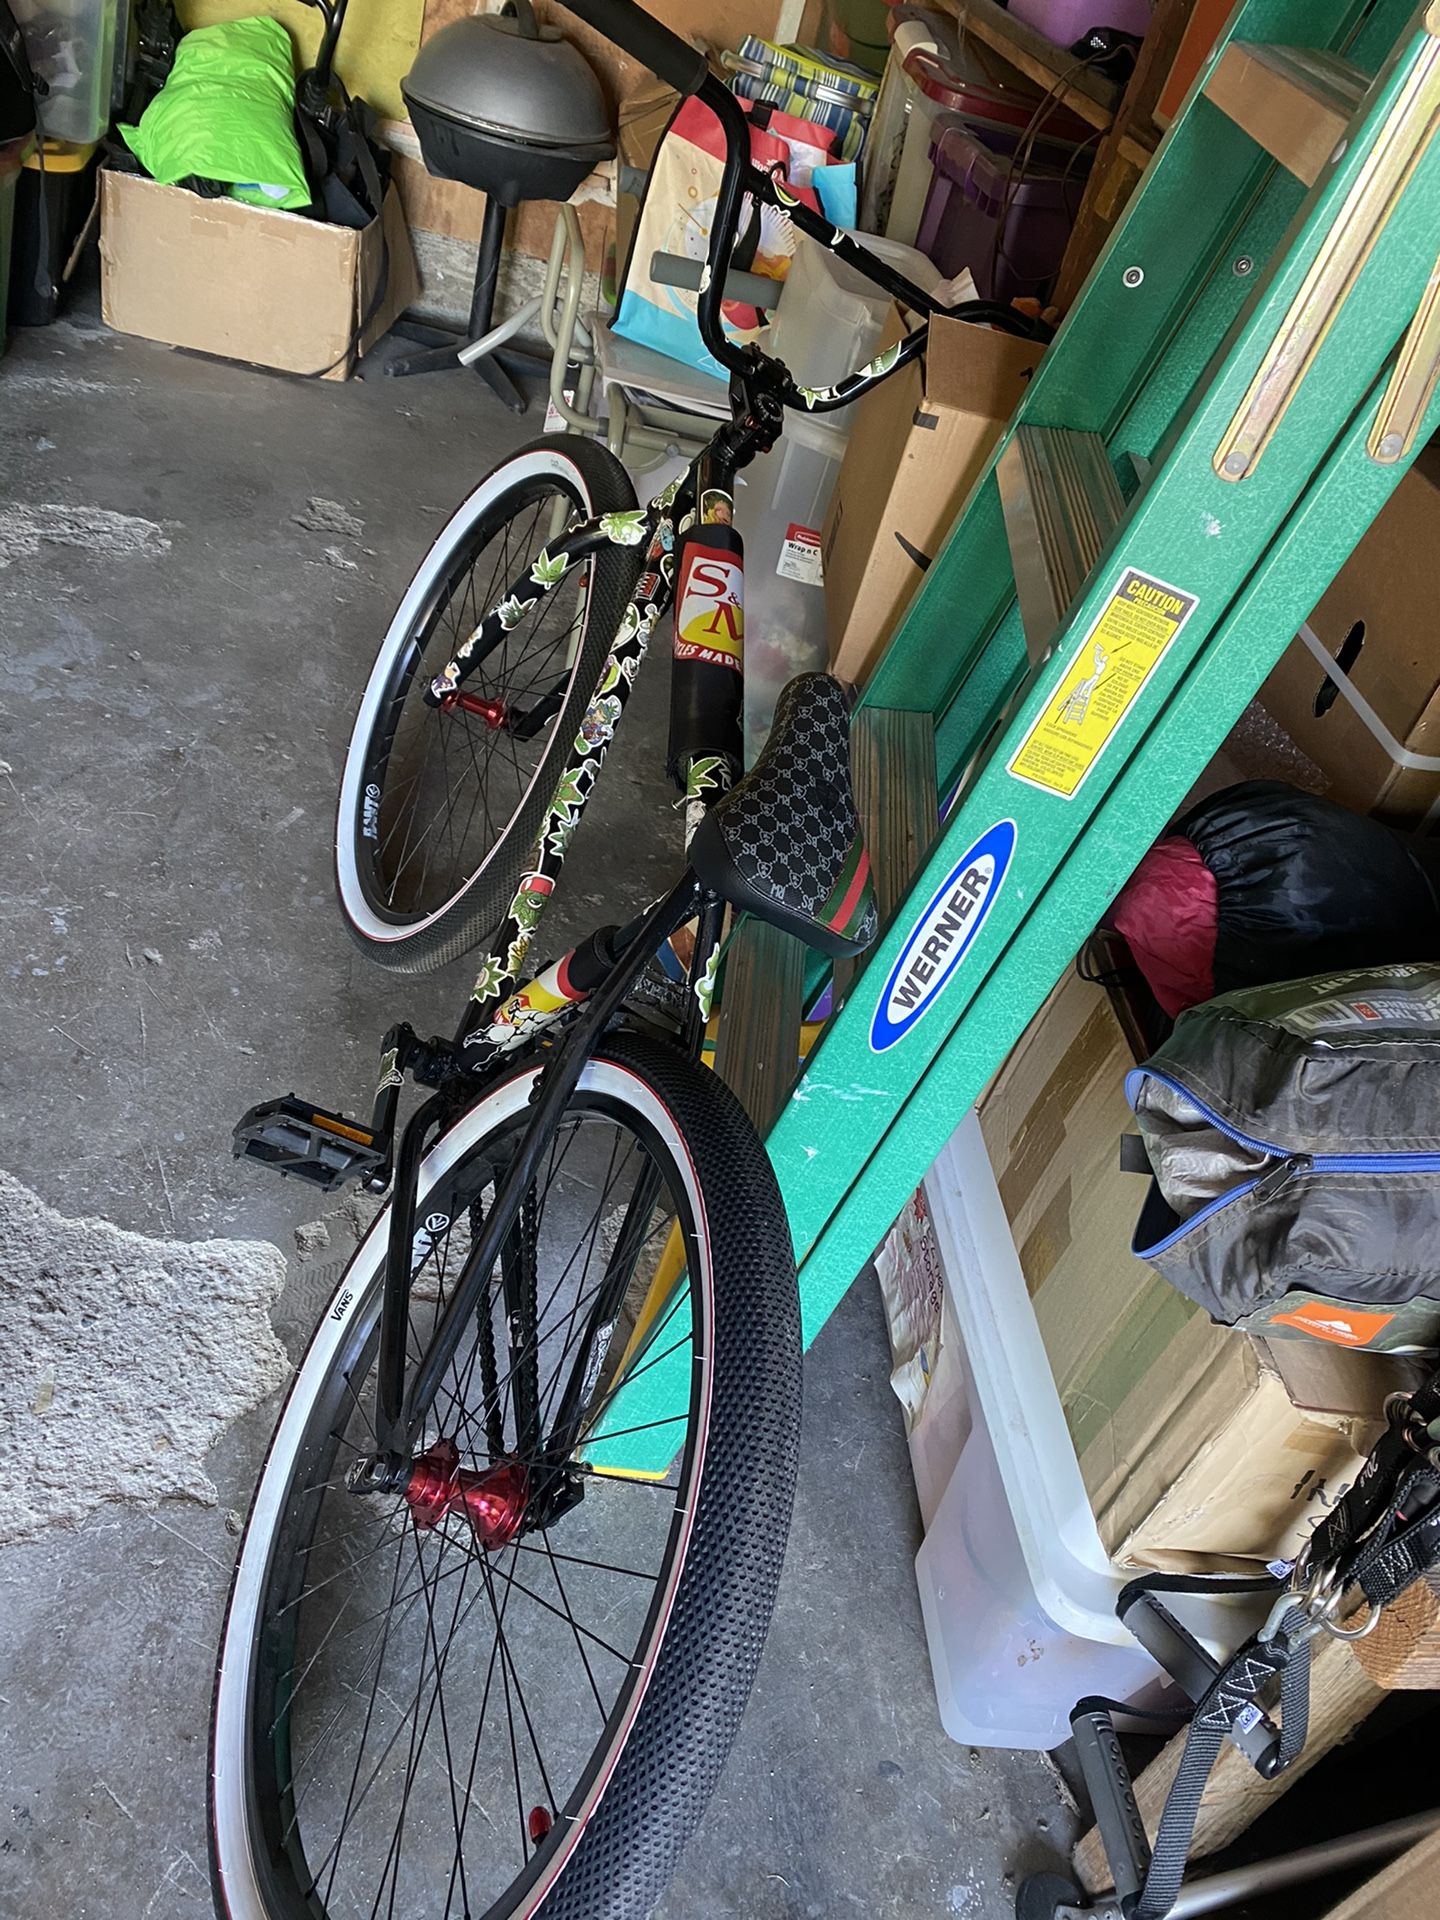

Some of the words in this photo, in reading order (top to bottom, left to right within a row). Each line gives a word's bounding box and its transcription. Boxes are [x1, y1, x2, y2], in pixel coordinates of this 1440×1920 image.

[788, 541, 805, 553] Wrap
[1126, 579, 1185, 615] CAUTION
[892, 867, 990, 1010] WERNER
[920, 1235, 940, 1313] Storage
[331, 1289, 354, 1321] VANS
